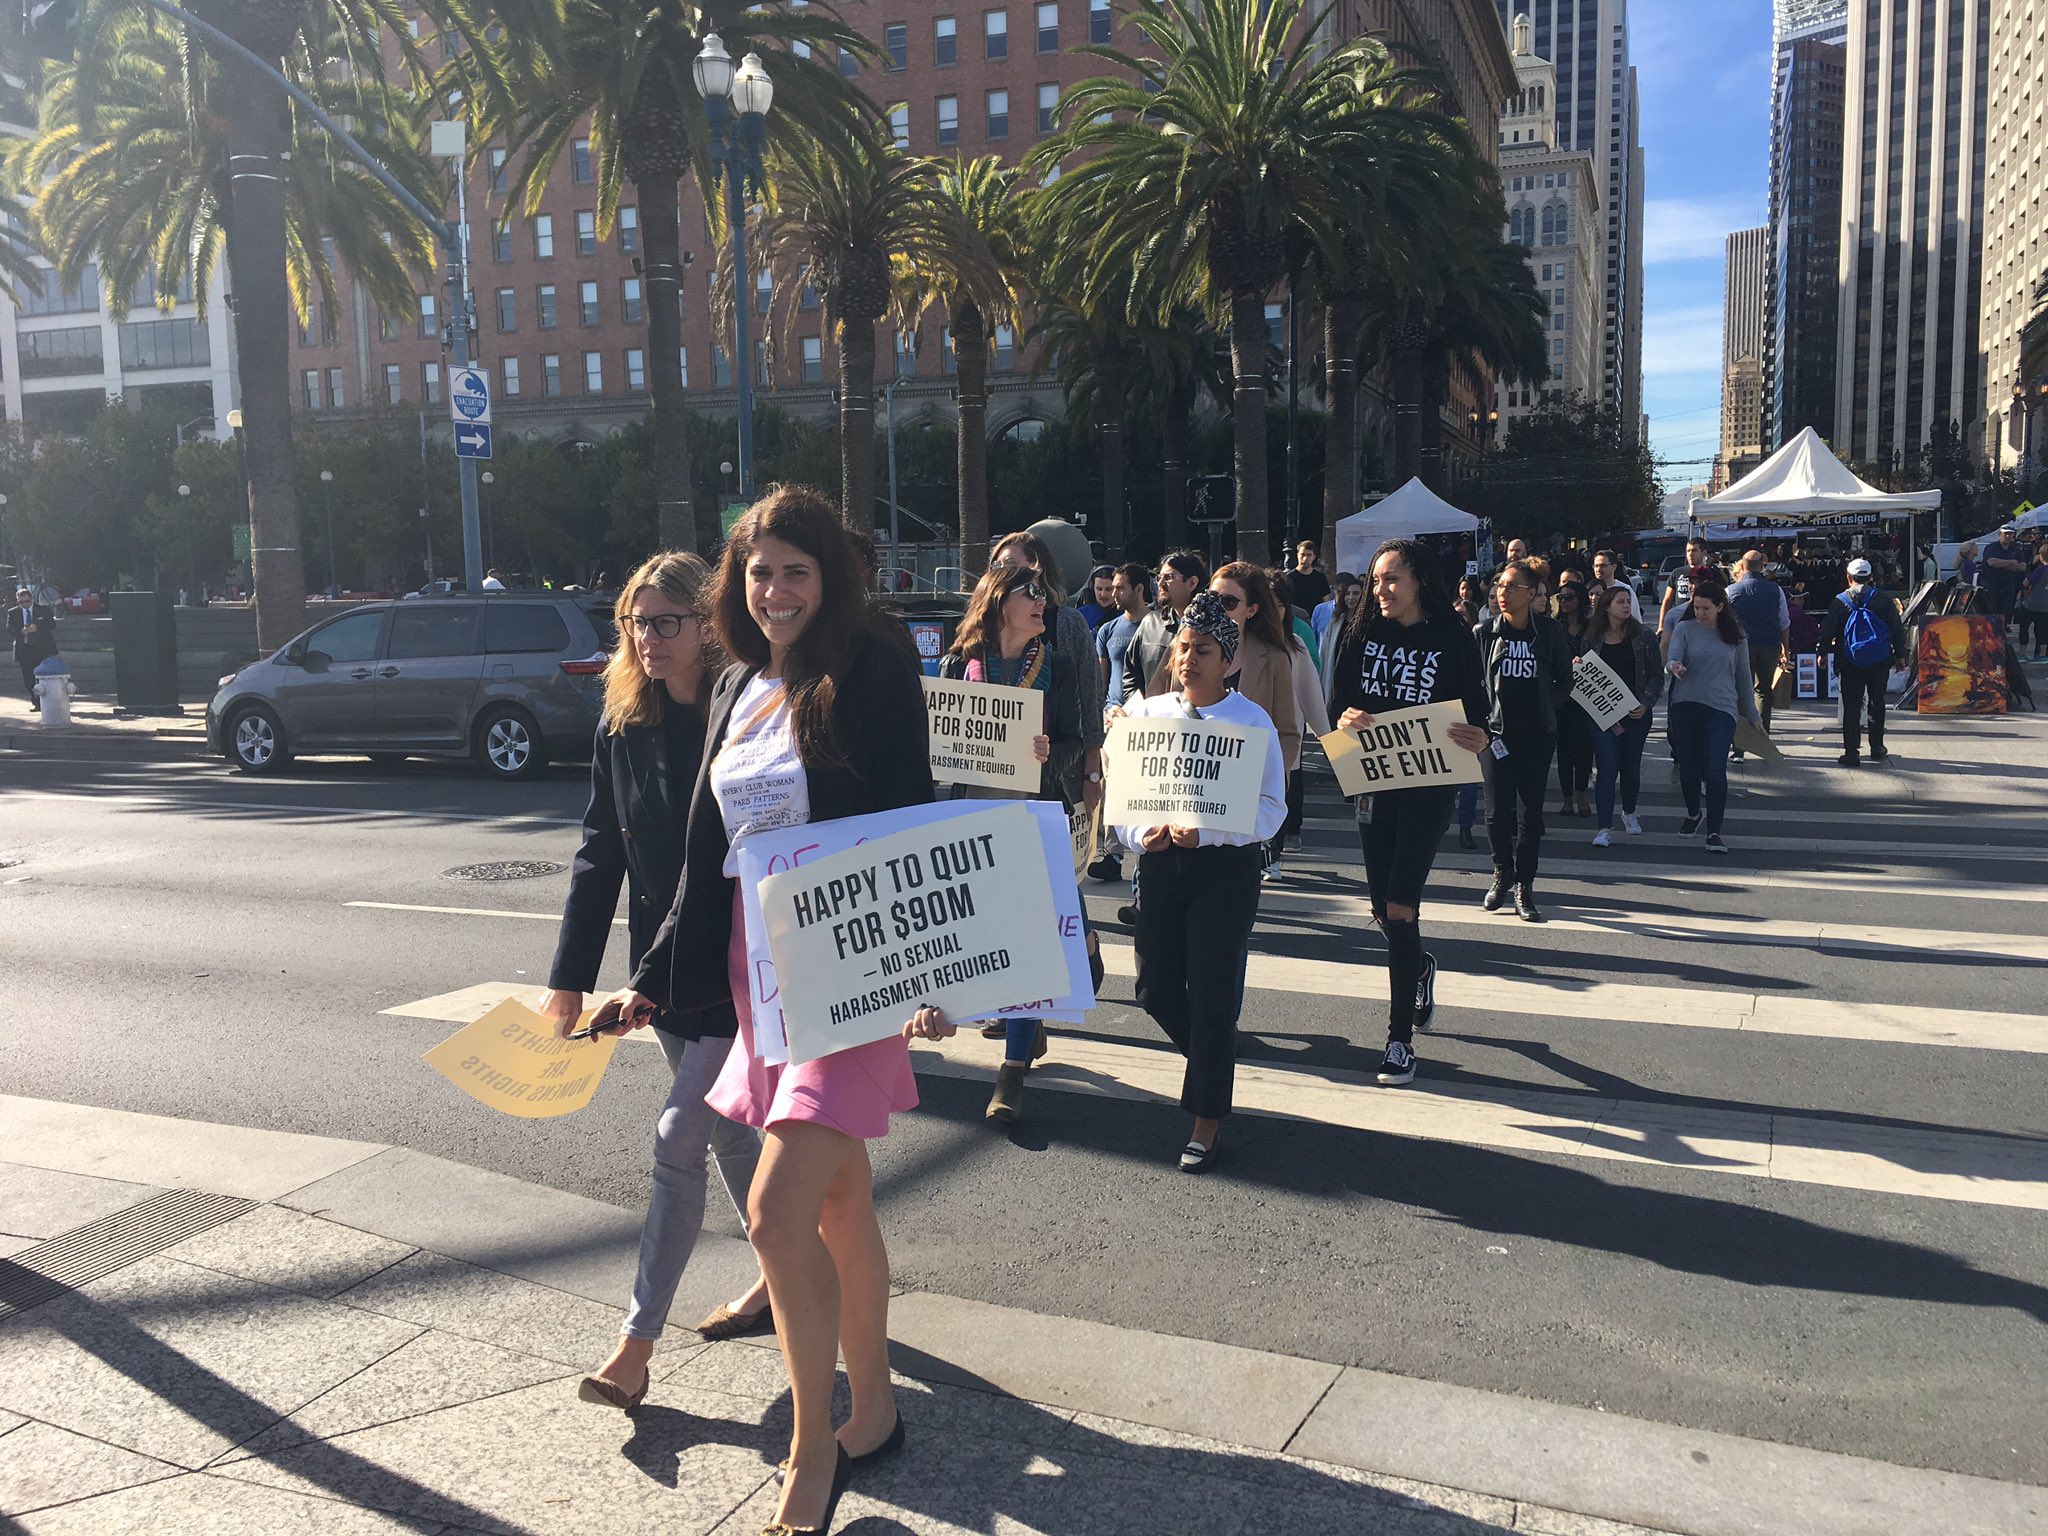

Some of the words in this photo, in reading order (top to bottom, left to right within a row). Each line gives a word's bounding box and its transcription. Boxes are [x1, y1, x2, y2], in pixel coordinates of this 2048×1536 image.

[456, 396, 485, 407] EVACUATION
[464, 406, 478, 415] ROUTE
[1834, 513, 1877, 526] Designs
[916, 632, 940, 643] RALPH
[1364, 640, 1442, 668] BLACK
[1362, 656, 1436, 688] LIVES
[1580, 662, 1614, 691] SPEAK
[1607, 687, 1624, 706] UP,
[1361, 678, 1432, 704] MATTER
[1572, 671, 1599, 699] SPEAK
[1592, 695, 1614, 716] OUT
[925, 691, 965, 713] APPY
[970, 696, 987, 716] TO
[992, 698, 1024, 720] QUIT
[934, 716, 960, 736] FOR
[965, 718, 1006, 742] $90M
[1357, 718, 1432, 753] DON'T
[953, 742, 963, 754] NO
[966, 744, 995, 758] SEXUAL
[1127, 732, 1176, 752] HAPPY
[1181, 732, 1200, 753] TO
[1205, 735, 1245, 759] QUIT
[930, 755, 974, 770] RASSMENT
[976, 761, 1015, 776] REQUIRED
[1141, 756, 1168, 777] FOR
[1172, 756, 1221, 781] $90M
[1360, 754, 1394, 782] BE
[1397, 748, 1452, 776] EVIL
[722, 785, 743, 796] EVERY
[746, 782, 763, 791] CLUB
[765, 777, 794, 788] WOMAN
[733, 798, 750, 807] PARIS
[754, 792, 790, 804] PATTERNS
[1159, 784, 1171, 795] NO
[1172, 784, 1204, 796] SEXUAL
[1127, 799, 1180, 812] HARASSMENT
[1183, 800, 1227, 816] REQUIRED
[793, 866, 878, 928] HAPPY
[885, 853, 923, 894] TO
[929, 834, 995, 881] QUIT
[832, 914, 886, 960] FOR
[890, 883, 976, 940] $90M
[880, 952, 902, 977] NO
[906, 933, 962, 967] SEXUAL
[830, 972, 930, 1025] HARASSMENT
[935, 948, 1010, 989] REQUIRED
